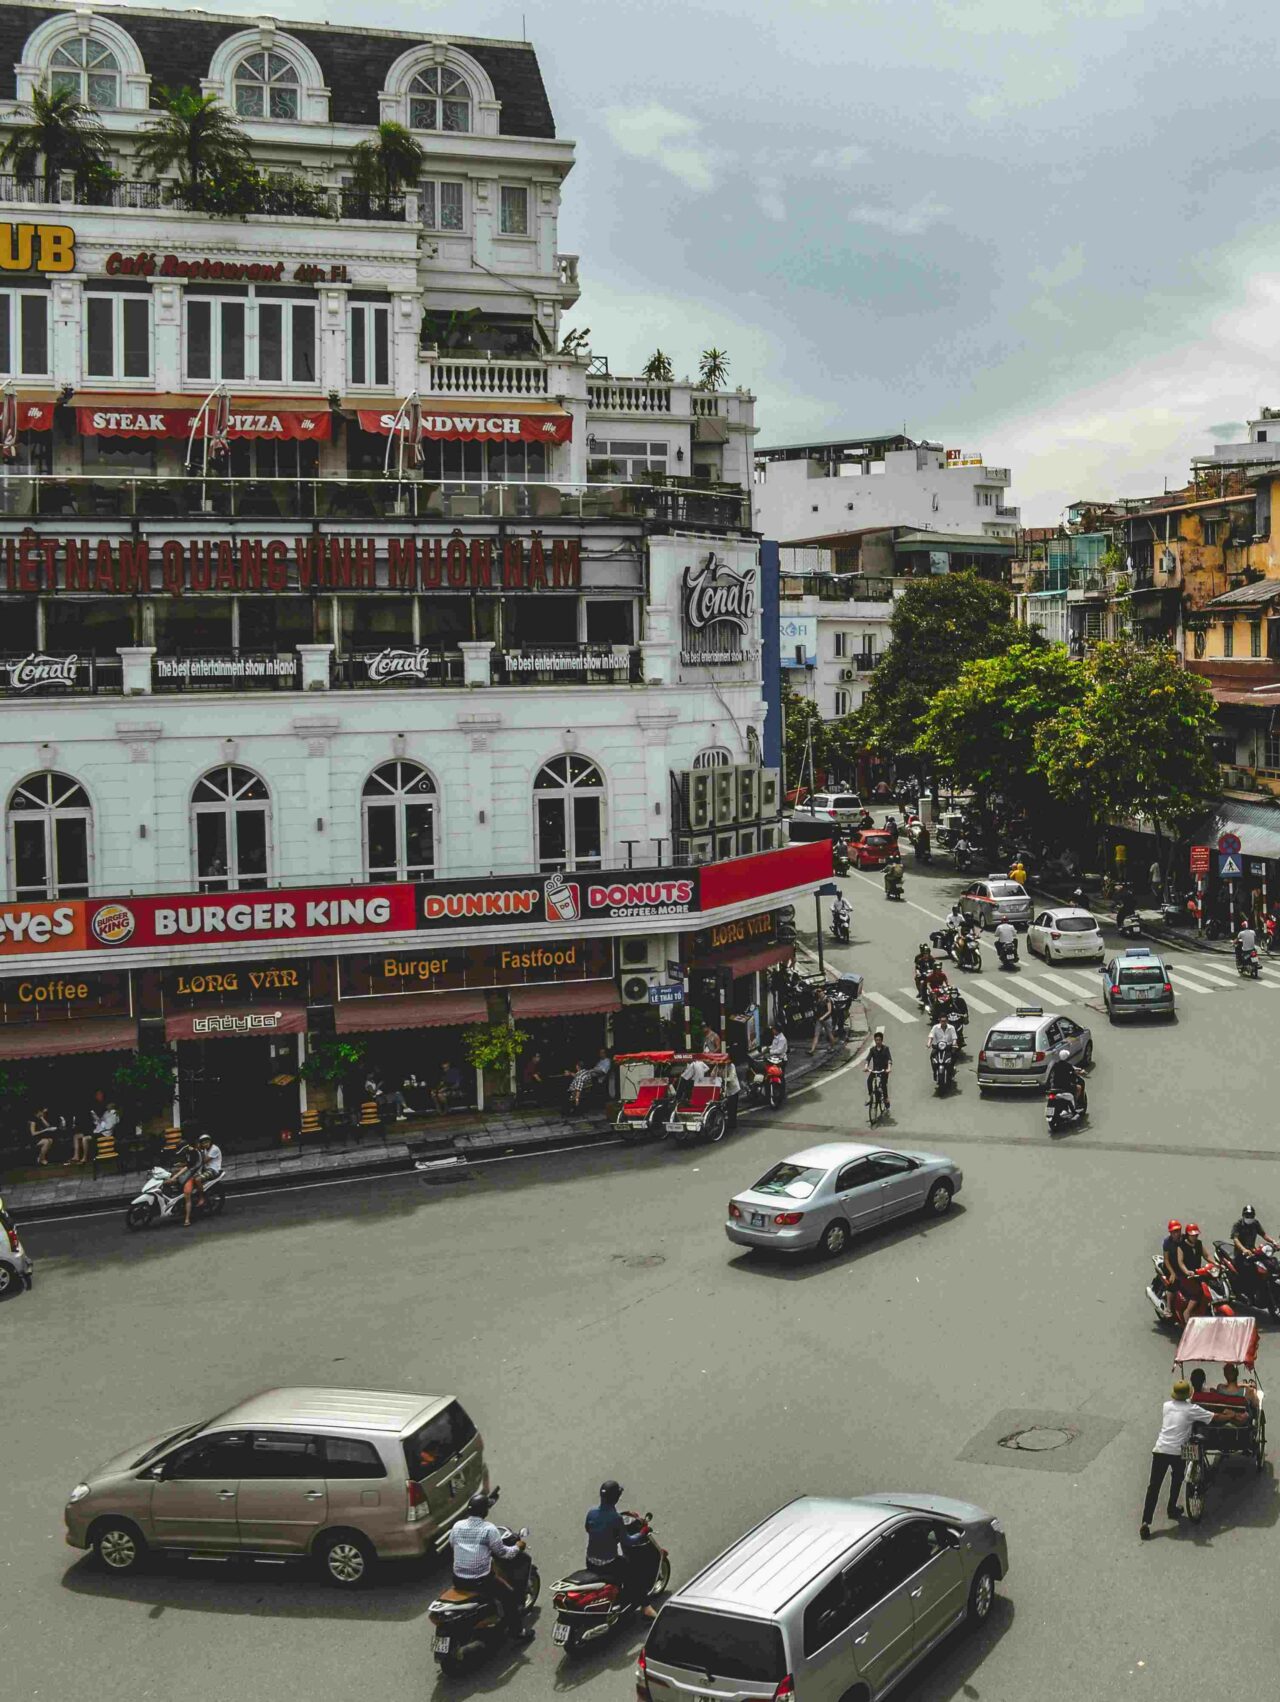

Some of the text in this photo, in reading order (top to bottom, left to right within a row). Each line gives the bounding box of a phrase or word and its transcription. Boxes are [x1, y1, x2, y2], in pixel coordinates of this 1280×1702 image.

[160, 254, 285, 282] Restaurant
[93, 412, 166, 431] STEAK
[65, 539, 151, 592] NAM
[161, 540, 289, 597] QUANG
[294, 537, 376, 589] VINH
[387, 528, 491, 588] MUÔN
[503, 529, 581, 588] NĂM
[158, 659, 297, 677] The best entertainment show in Hanoi
[505, 654, 630, 671] The best entertainment show in Hanoi
[424, 880, 693, 919] DUNKIN' DONUTS
[97, 911, 129, 927] BURGER
[155, 897, 391, 936] BURGER KING
[610, 908, 651, 917] COFFEE
[658, 905, 689, 914] MORE
[99, 918, 130, 936] KING
[384, 958, 448, 979] Burger
[502, 946, 576, 970] Fastfood
[18, 981, 88, 1003] Coffee
[177, 973, 238, 994] LONG
